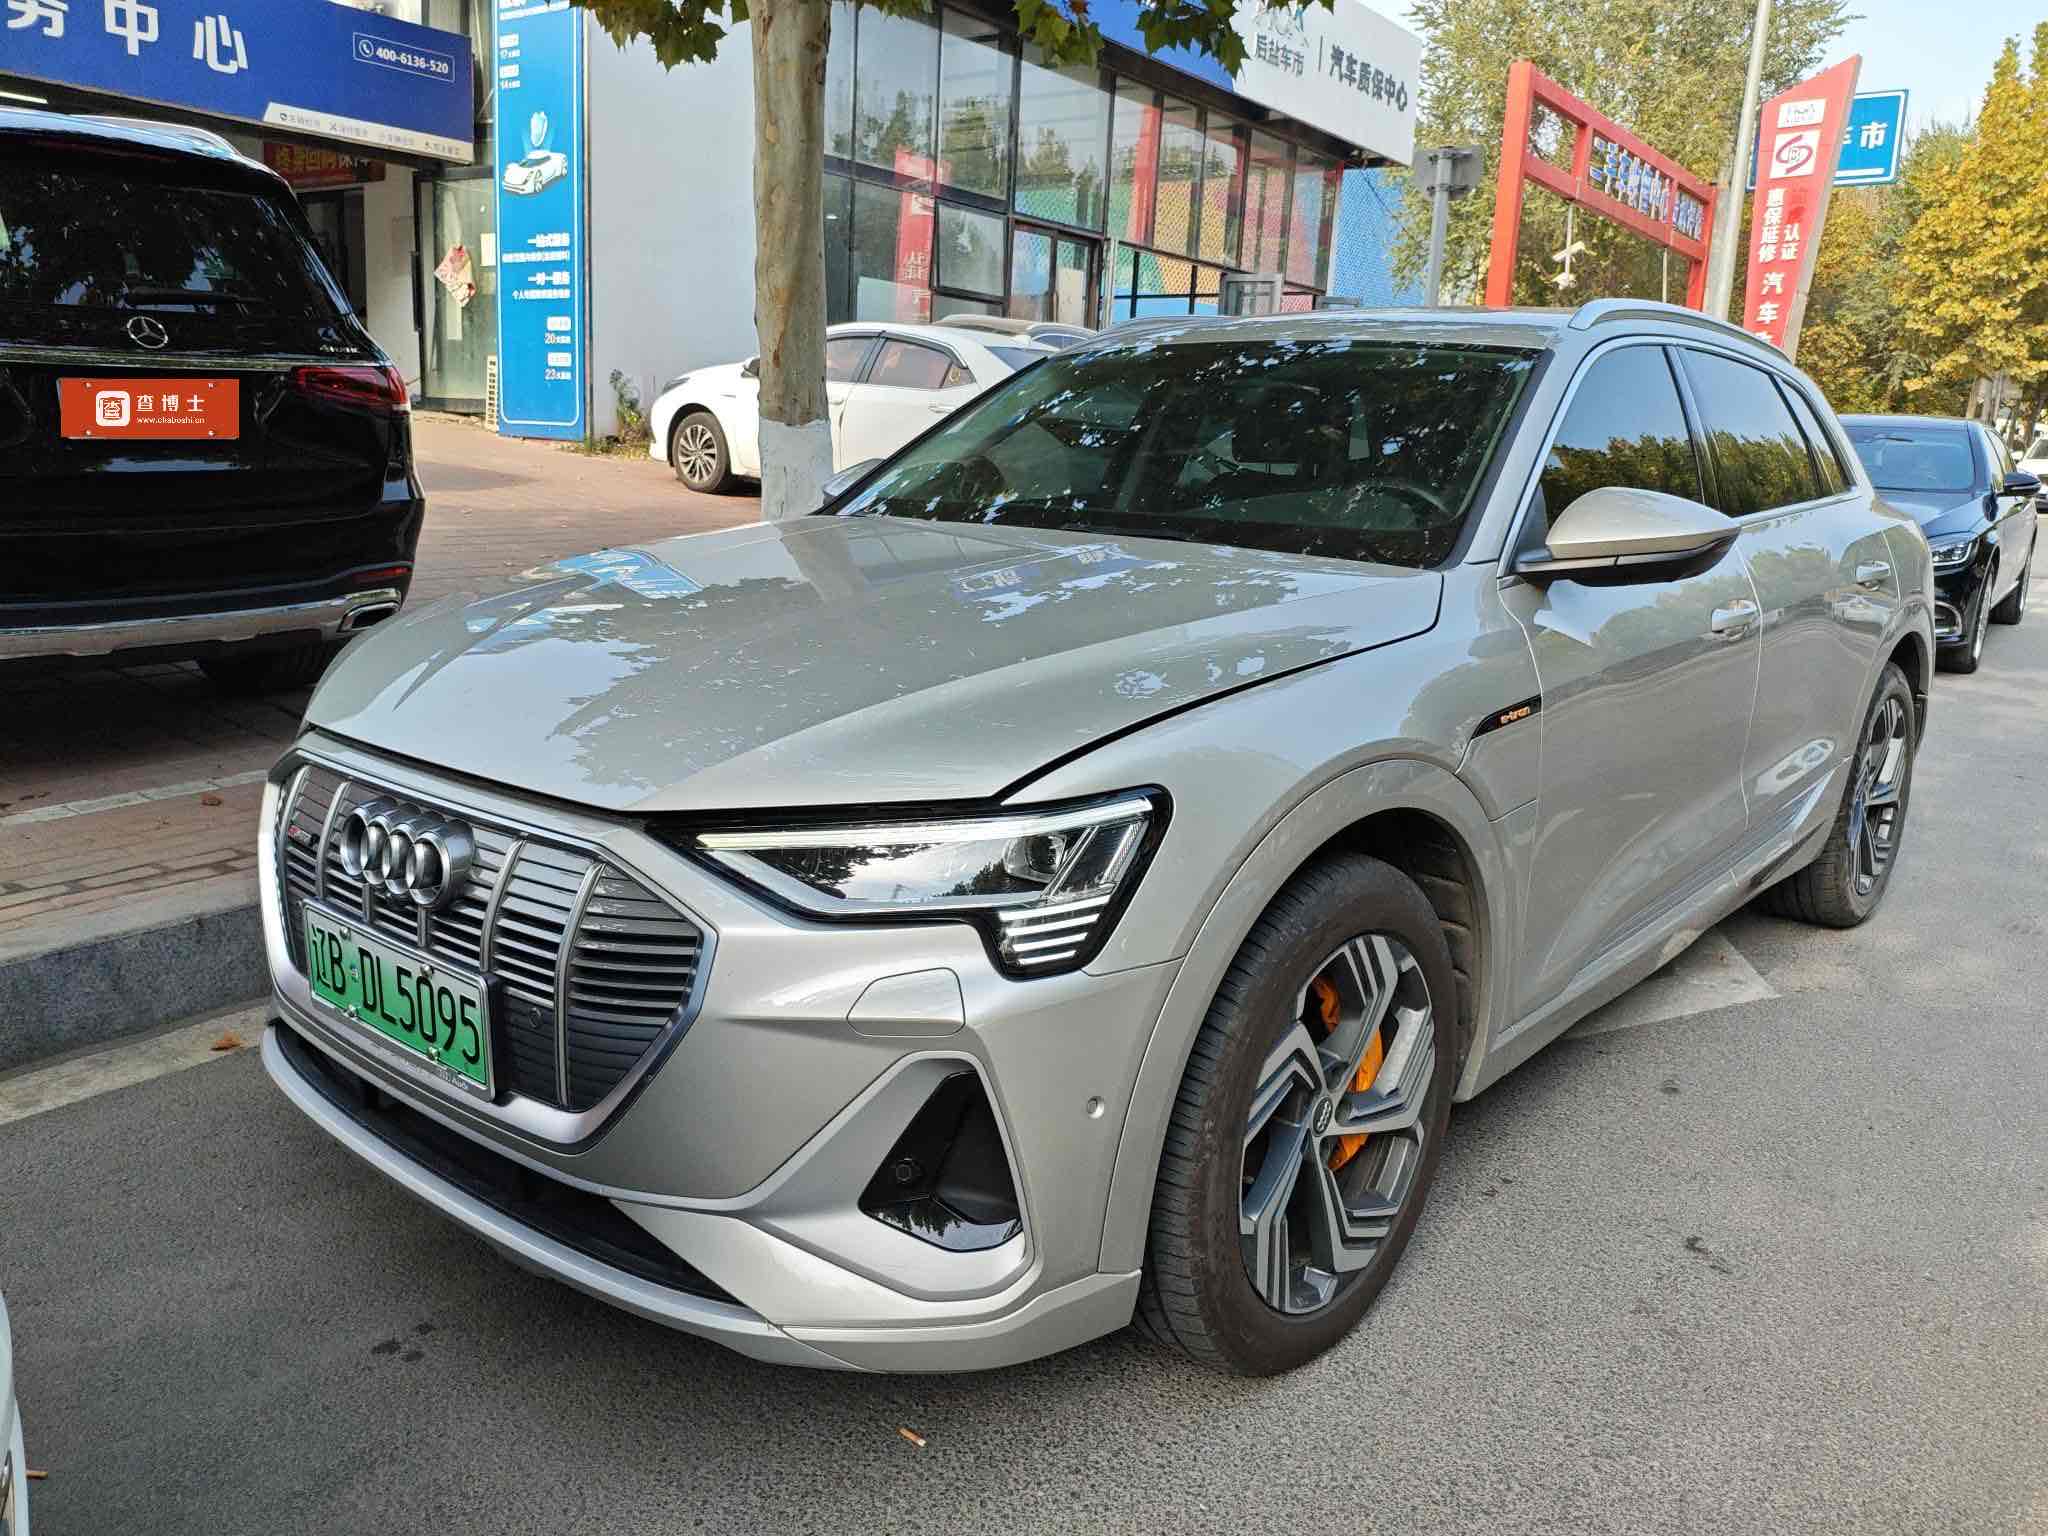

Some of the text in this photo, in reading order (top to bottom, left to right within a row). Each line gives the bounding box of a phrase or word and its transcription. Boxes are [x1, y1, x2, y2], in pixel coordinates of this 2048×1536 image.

[376, 46, 449, 75] 400-6136-520
[1329, 44, 1408, 112] 汽车质保中心
[1780, 222, 1801, 261] 认证
[358, 946, 481, 1066] DL5095
